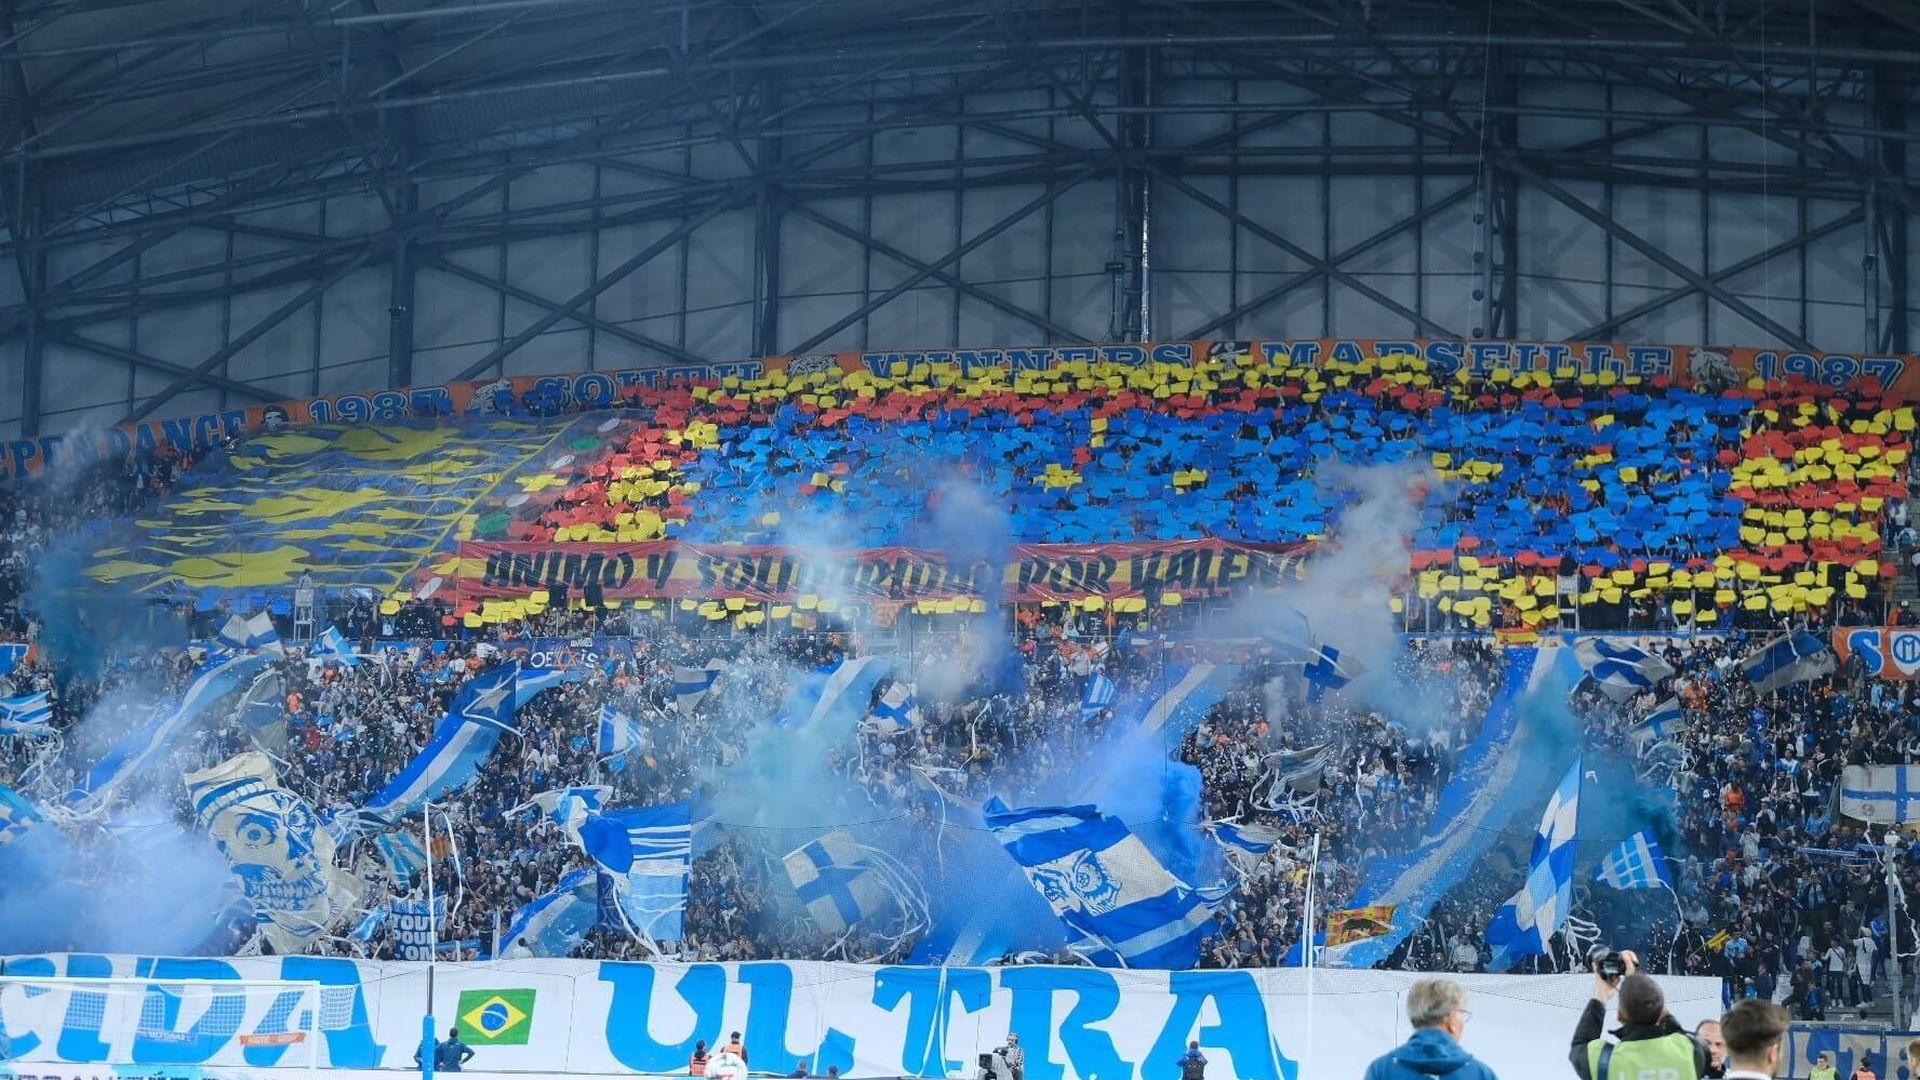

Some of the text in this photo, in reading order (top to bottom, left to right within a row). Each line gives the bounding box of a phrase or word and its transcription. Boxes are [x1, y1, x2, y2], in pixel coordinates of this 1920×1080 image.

[1754, 352, 1904, 393] 1987
[482, 550, 635, 590] ANIMO
[1018, 554, 1115, 594] POR
[599, 961, 1298, 1080] ULTRA
